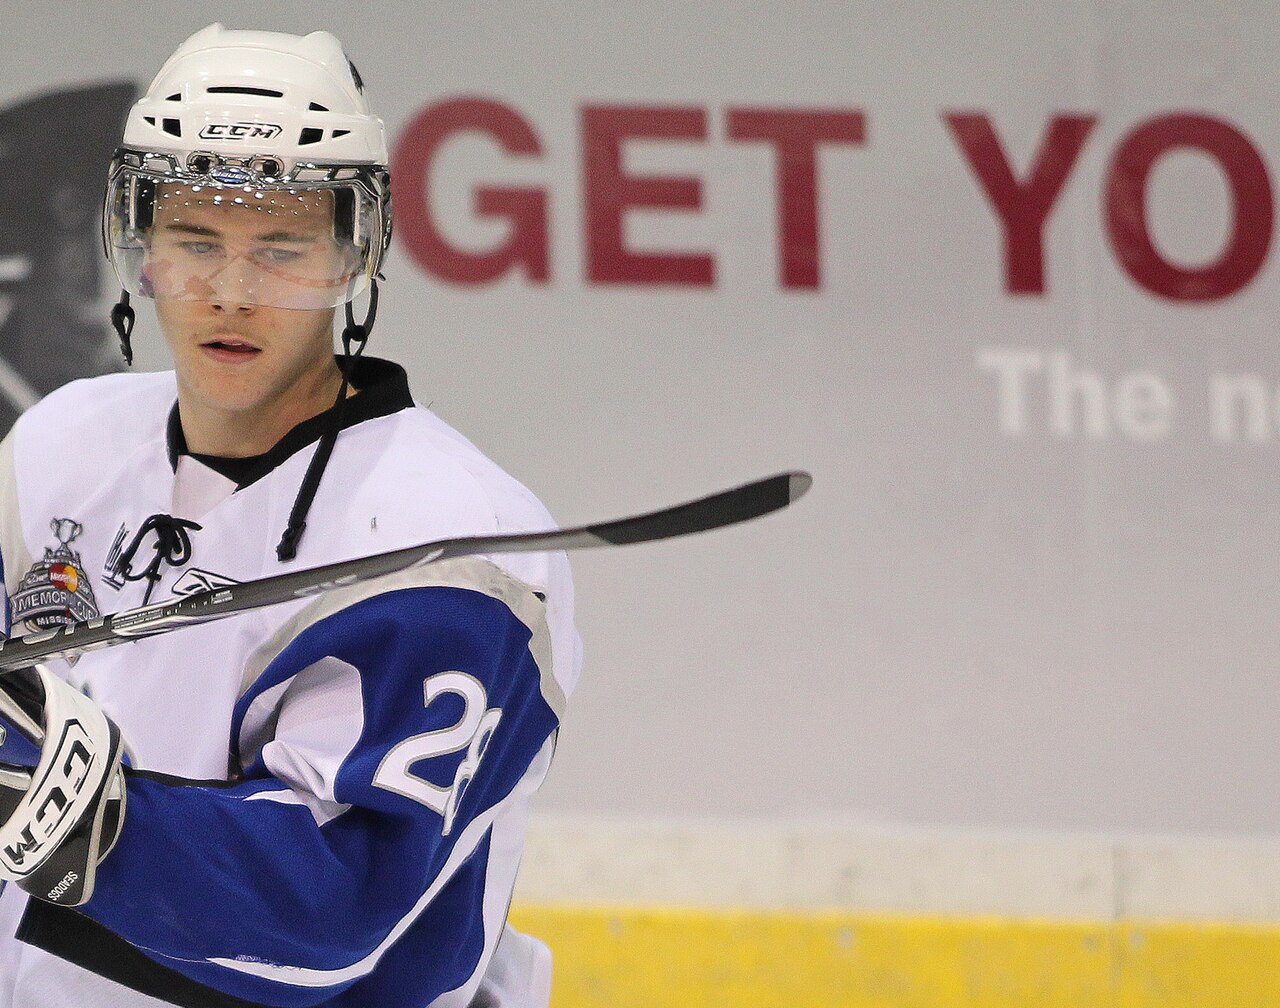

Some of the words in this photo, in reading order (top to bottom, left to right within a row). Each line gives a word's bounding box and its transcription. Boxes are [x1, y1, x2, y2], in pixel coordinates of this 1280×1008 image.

[206, 123, 276, 139] CCM
[393, 93, 866, 289] GET
[941, 110, 1275, 304] YO
[977, 345, 1172, 440] The
[2, 738, 93, 866] CCM
[47, 871, 79, 901] SEADOGS
